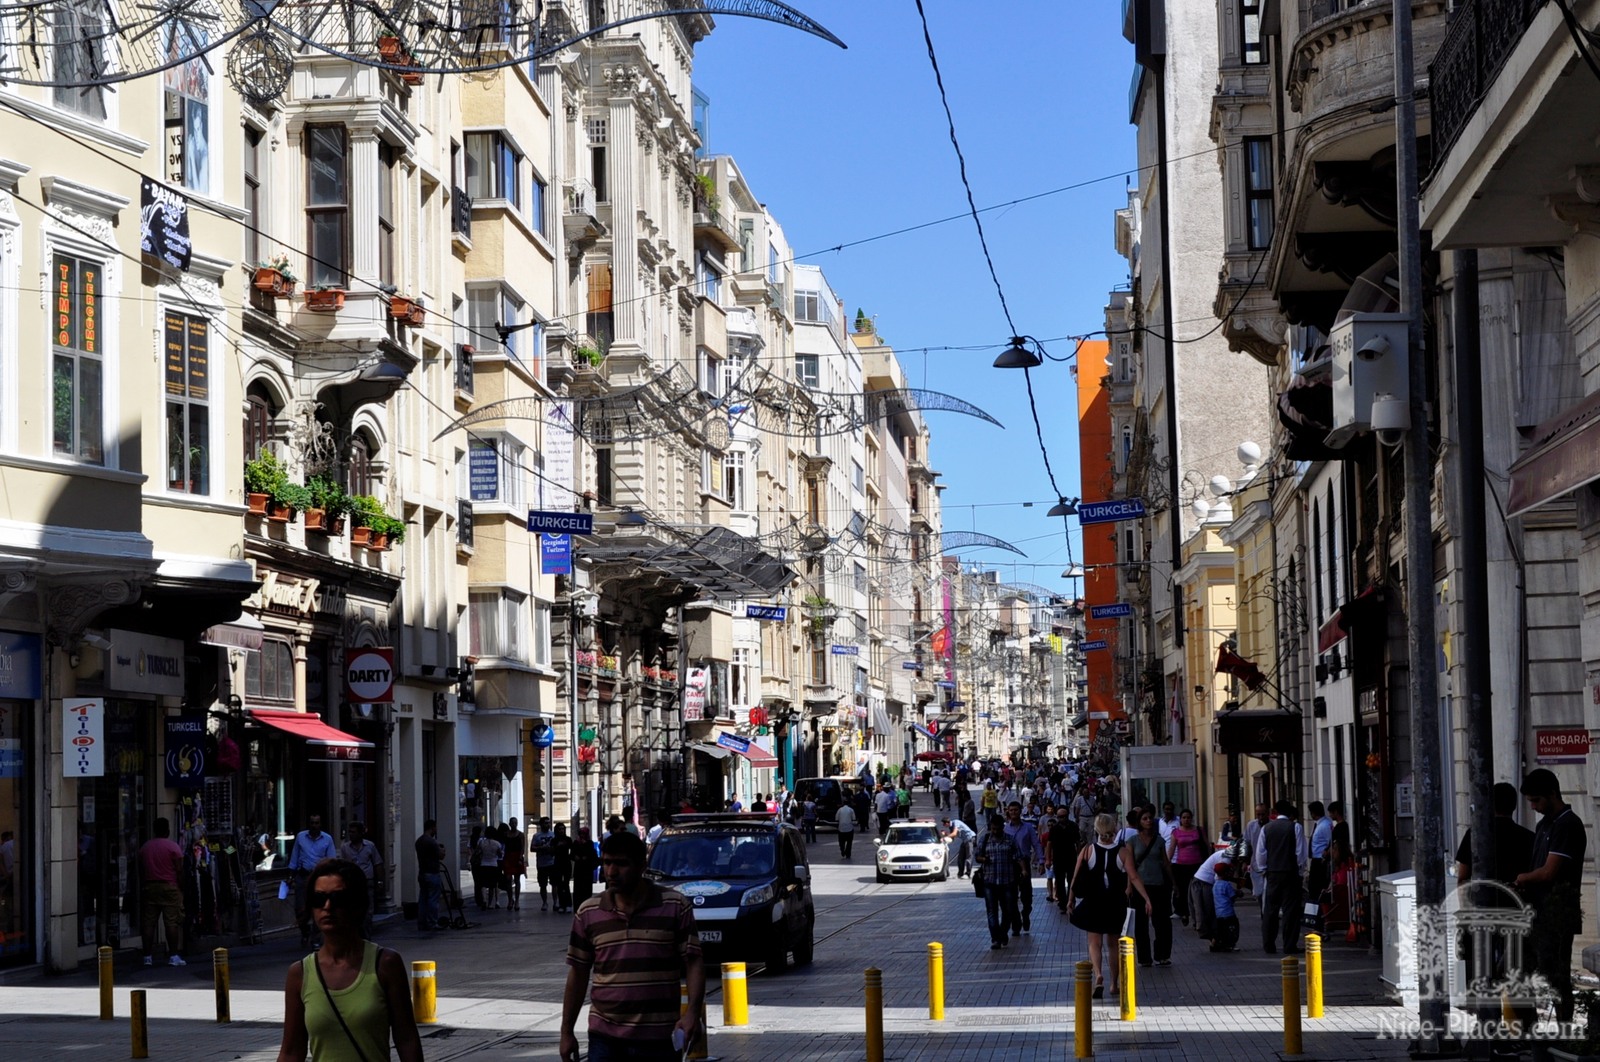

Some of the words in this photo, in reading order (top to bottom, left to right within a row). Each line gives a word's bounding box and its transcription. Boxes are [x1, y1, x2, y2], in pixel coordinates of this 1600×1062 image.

[59, 264, 70, 347] TEMPO
[1080, 502, 1143, 519] TURKCELL
[529, 516, 590, 530] TURKCELL
[1092, 604, 1129, 616] TURKCELL
[1080, 642, 1106, 650] TURKCELL
[147, 655, 180, 676] TURKCELL
[349, 668, 393, 683] DARTY
[168, 722, 202, 732] TURKCELL
[702, 932, 720, 940] 2147
